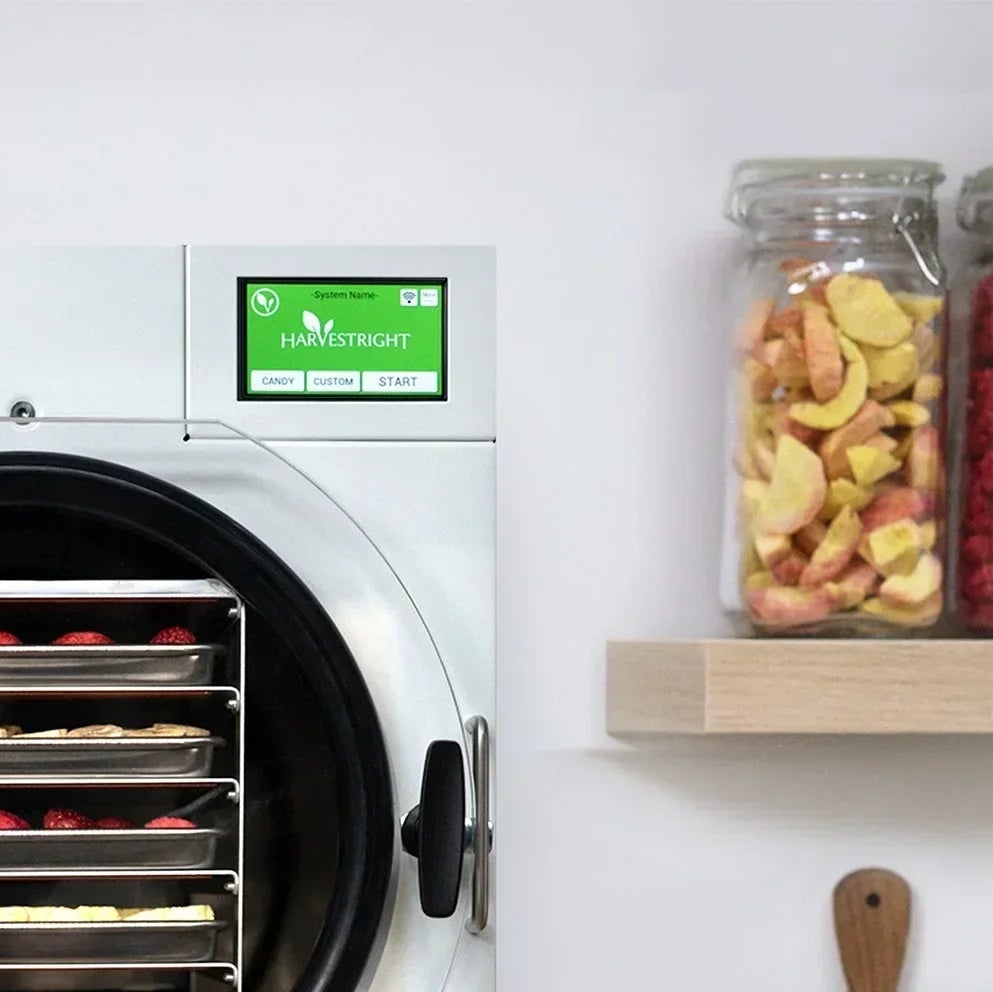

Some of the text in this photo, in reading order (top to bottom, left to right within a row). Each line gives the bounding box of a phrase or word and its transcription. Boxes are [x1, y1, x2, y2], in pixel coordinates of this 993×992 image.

[262, 376, 295, 386] CANDY
[313, 377, 354, 386] CUSTOM
[378, 376, 418, 387] START
